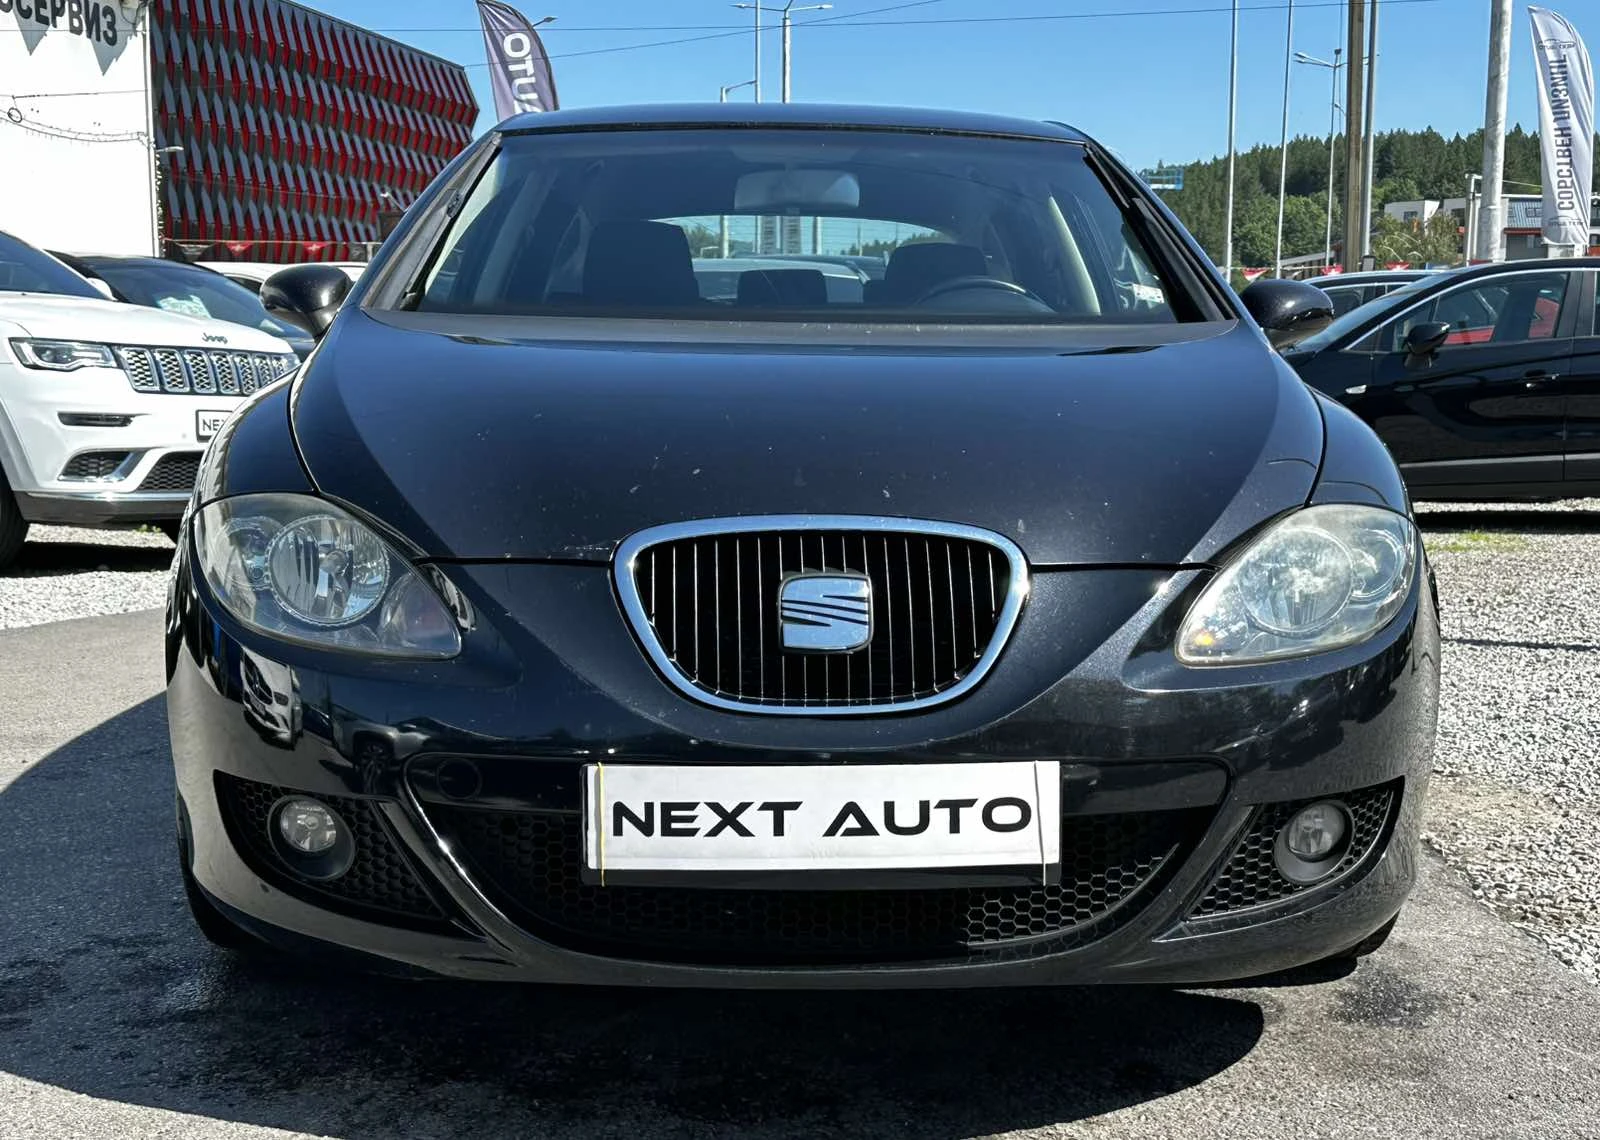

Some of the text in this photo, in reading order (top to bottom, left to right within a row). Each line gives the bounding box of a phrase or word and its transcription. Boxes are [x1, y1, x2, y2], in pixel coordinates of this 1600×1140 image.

[0, 0, 118, 46] СЕРВИЗ
[202, 419, 224, 431] NE
[613, 797, 1032, 837] NEXT AUTO
